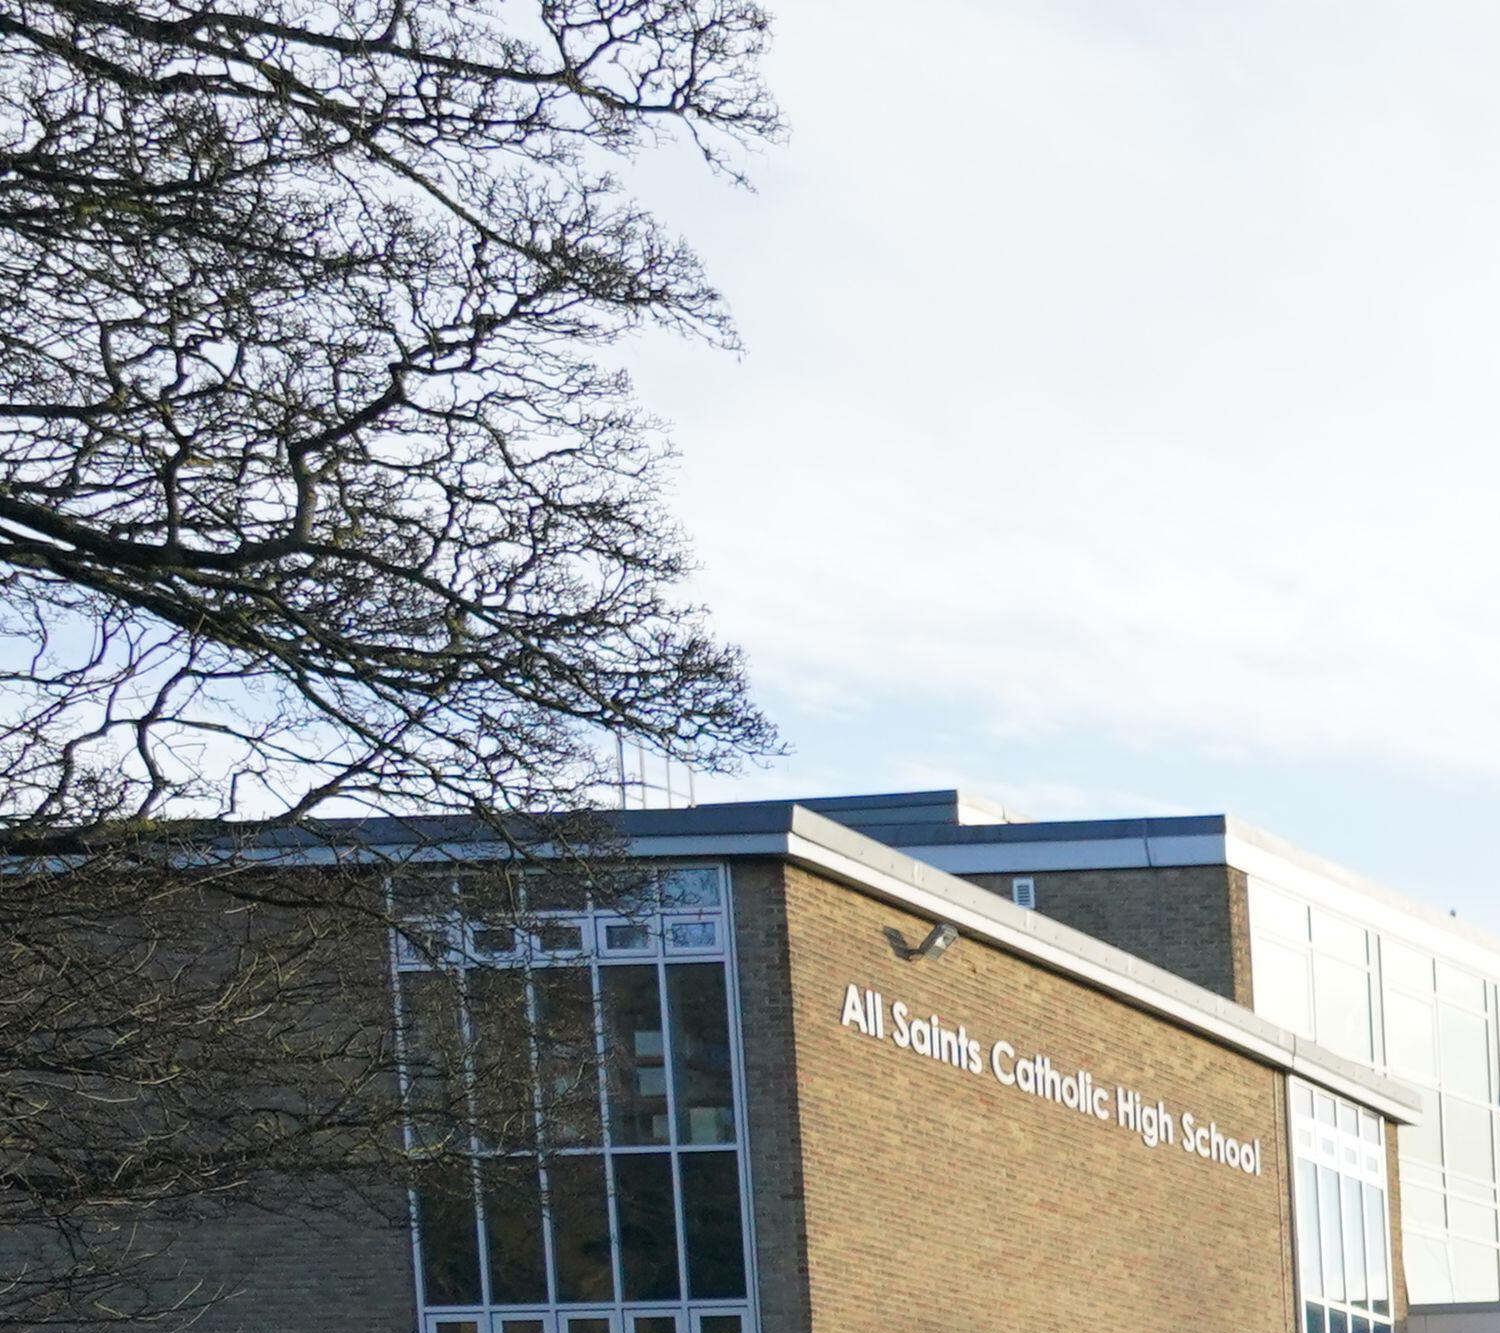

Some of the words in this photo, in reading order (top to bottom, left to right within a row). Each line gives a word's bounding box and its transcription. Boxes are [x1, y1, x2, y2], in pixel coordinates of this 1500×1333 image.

[841, 983, 884, 1038] All
[891, 1000, 982, 1075] Saints
[991, 1041, 1110, 1120] Catholic
[1116, 1087, 1174, 1148] High
[1182, 1113, 1260, 1176] School
